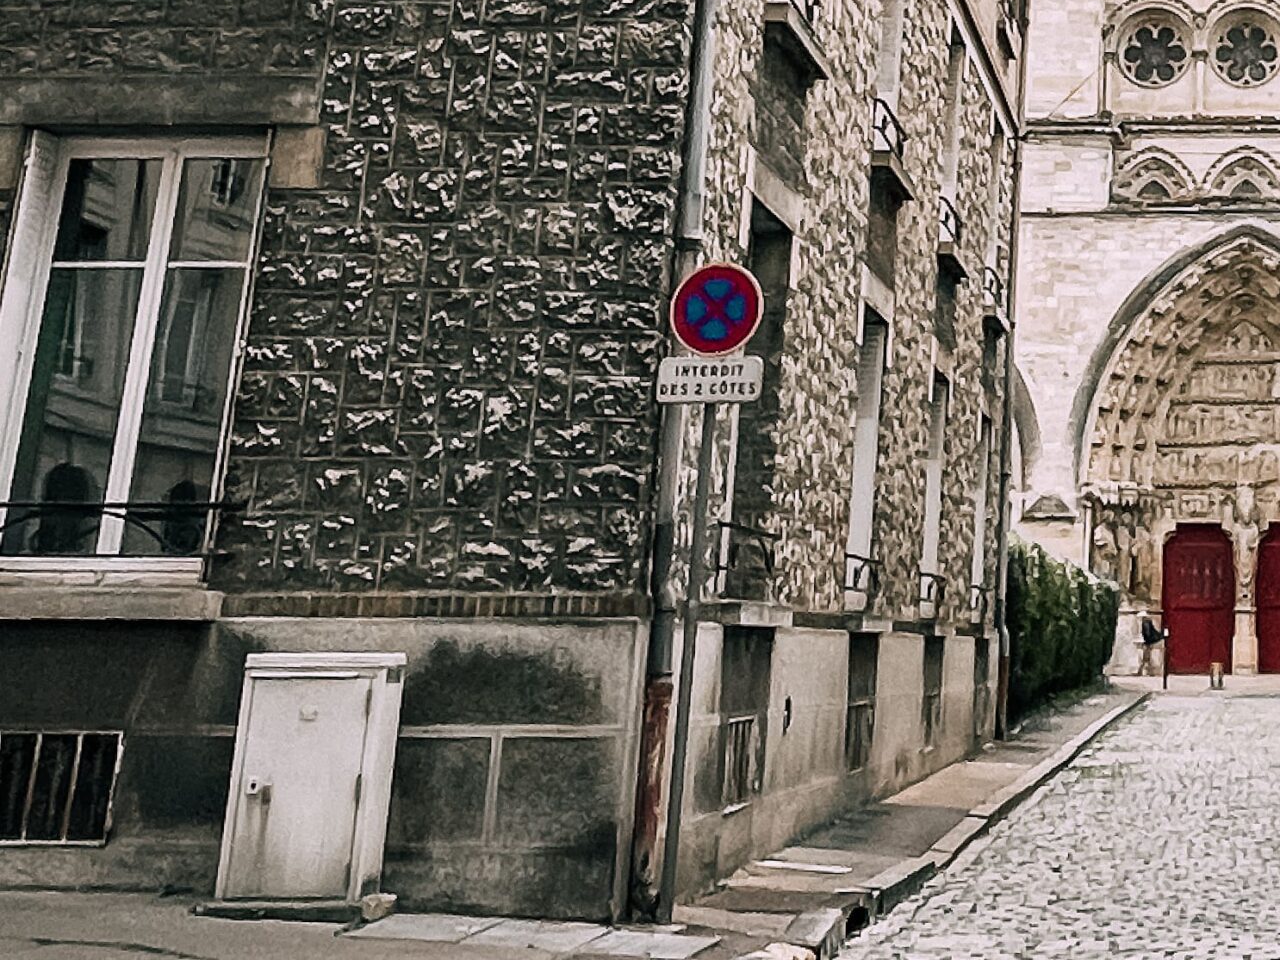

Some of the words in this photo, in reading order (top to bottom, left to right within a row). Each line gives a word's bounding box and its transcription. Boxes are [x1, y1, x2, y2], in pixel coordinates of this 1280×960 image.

[675, 364, 744, 377] INTERDIT
[659, 383, 688, 396] DES
[694, 383, 703, 395] 2
